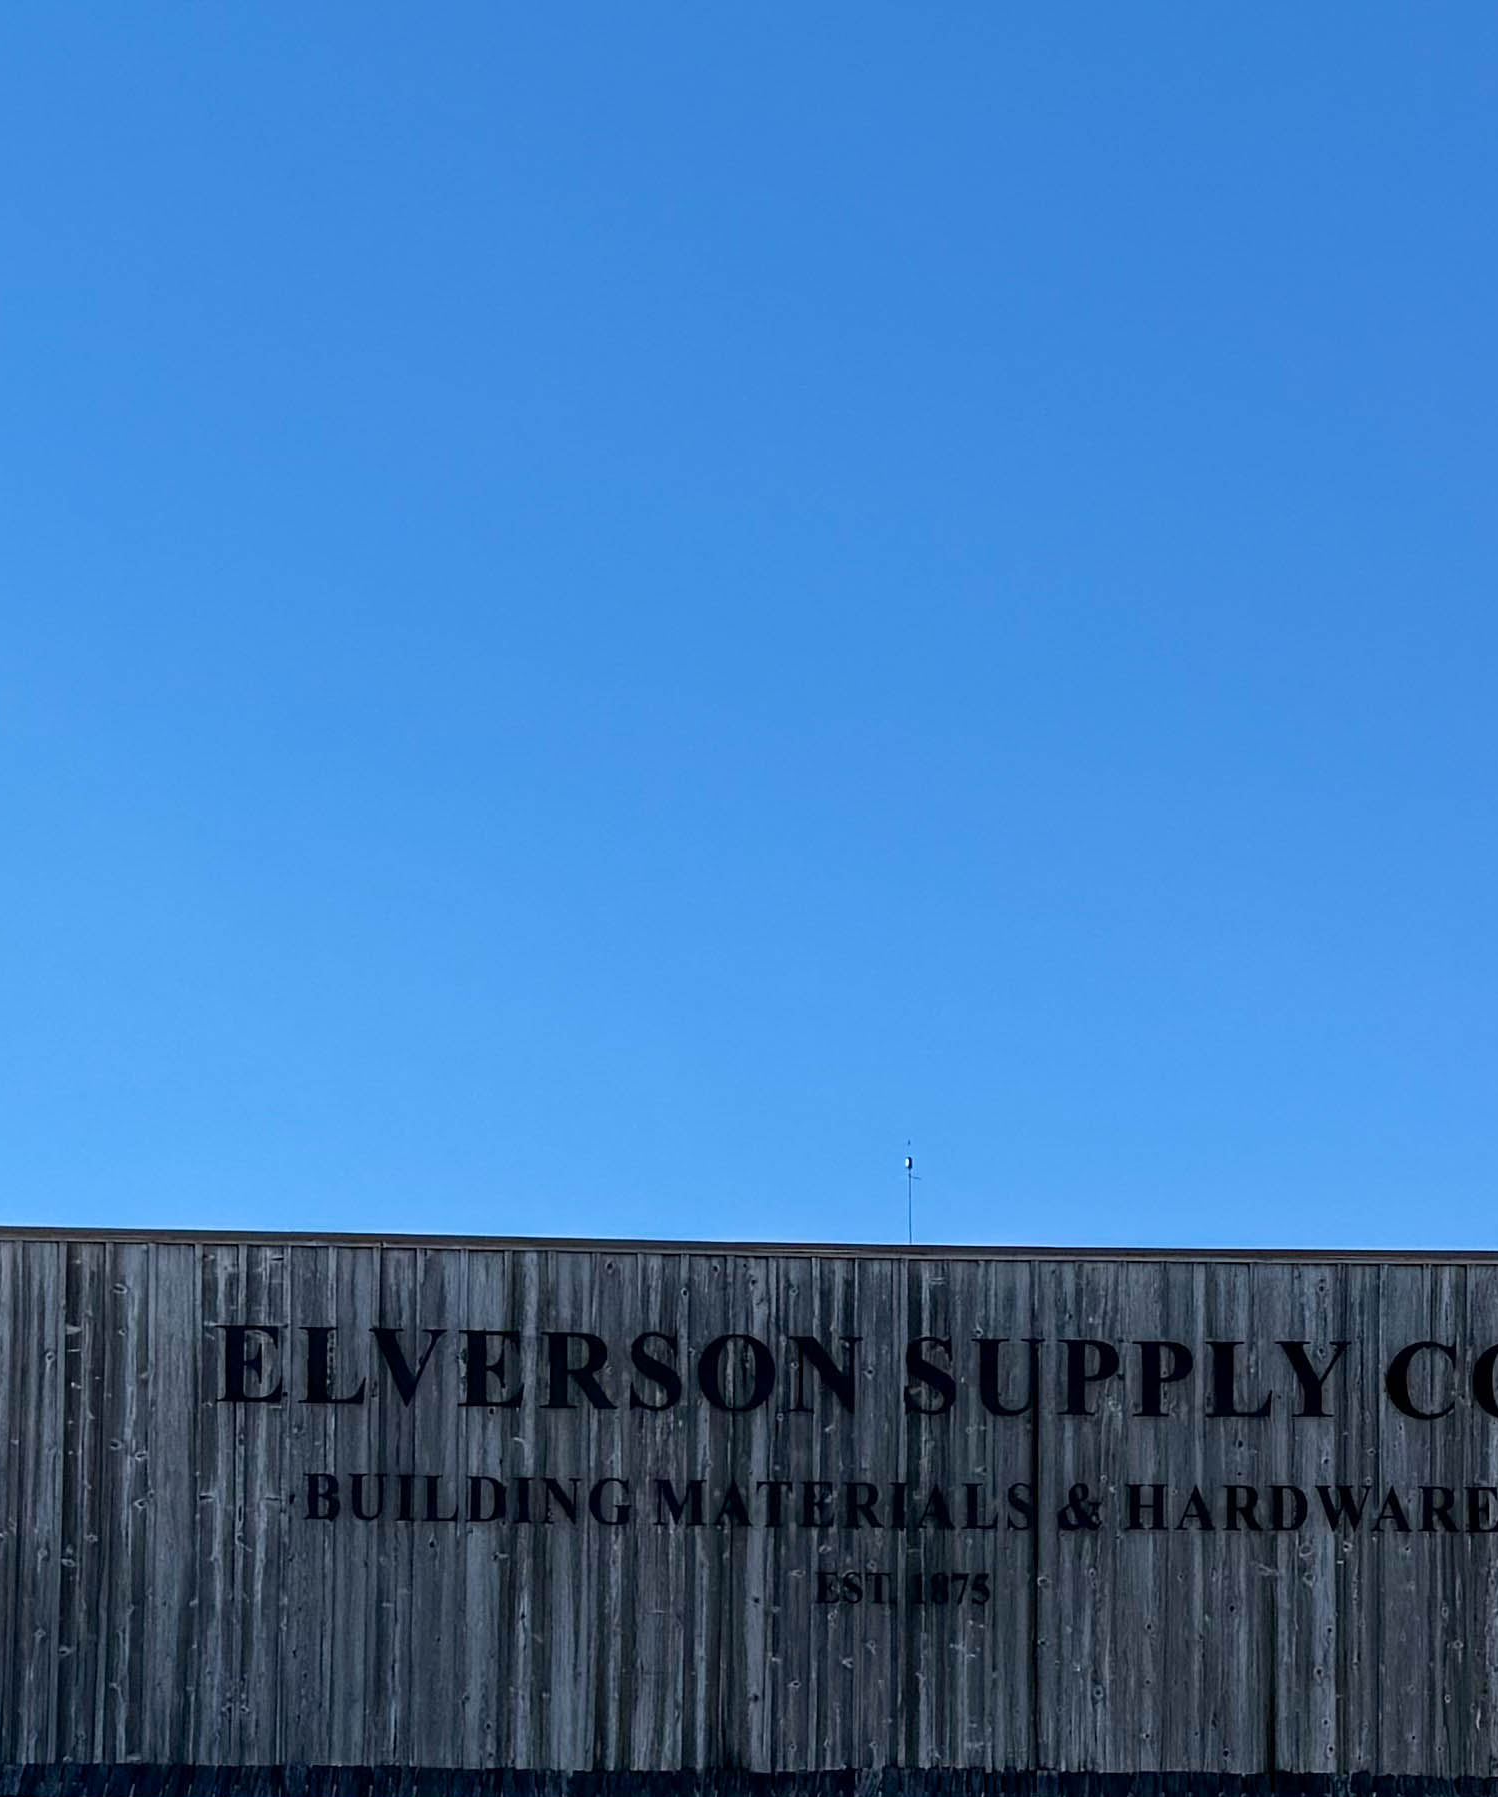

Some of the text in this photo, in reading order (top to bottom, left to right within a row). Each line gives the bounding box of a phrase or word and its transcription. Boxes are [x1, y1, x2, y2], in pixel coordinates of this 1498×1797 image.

[216, 1323, 862, 1414] ELVERSON
[903, 1333, 1349, 1419] SUPPLY
[302, 1472, 633, 1527] BUILDING
[653, 1478, 1036, 1531] MATERIALS
[1056, 1482, 1103, 1531] &
